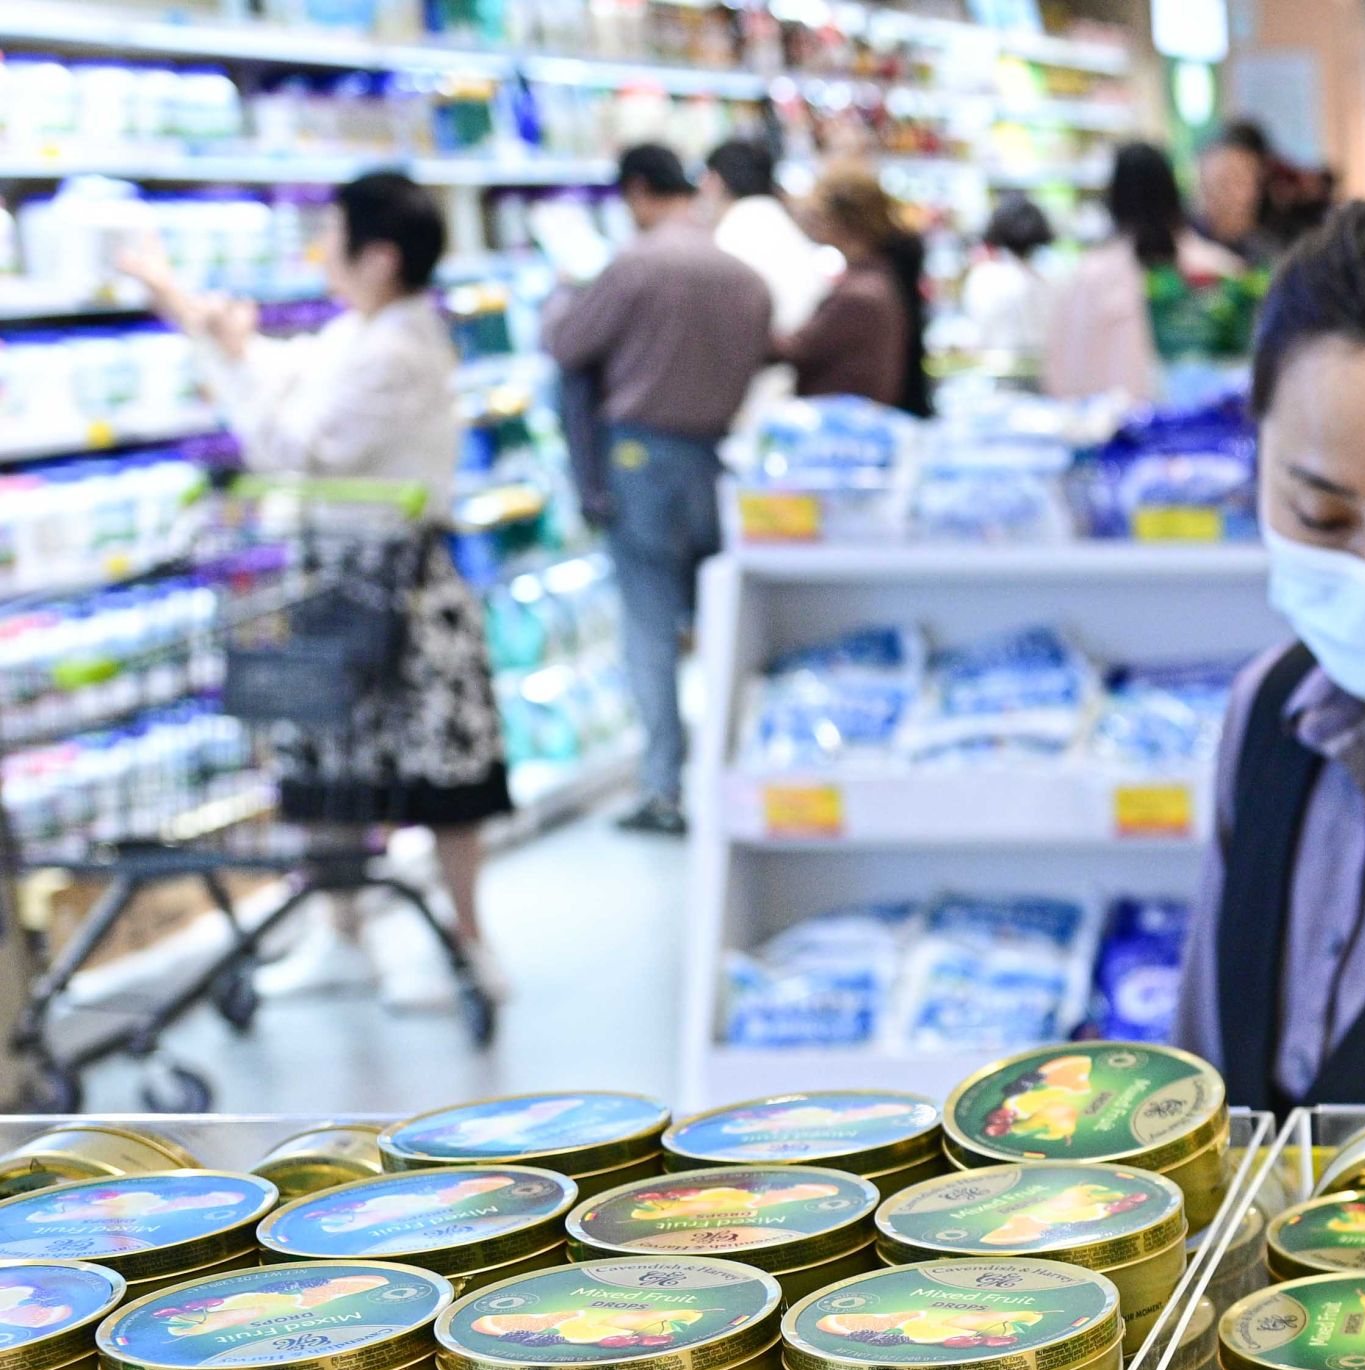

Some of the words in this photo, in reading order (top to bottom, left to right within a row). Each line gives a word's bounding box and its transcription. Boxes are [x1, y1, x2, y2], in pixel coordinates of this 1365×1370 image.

[911, 1288, 974, 1302] Mixed
[979, 1291, 1037, 1305] Fruit
[932, 1300, 989, 1312] DROPS
[250, 1311, 315, 1328] DROPS
[269, 1310, 362, 1334] Mixed
[214, 1324, 267, 1344] Fruit
